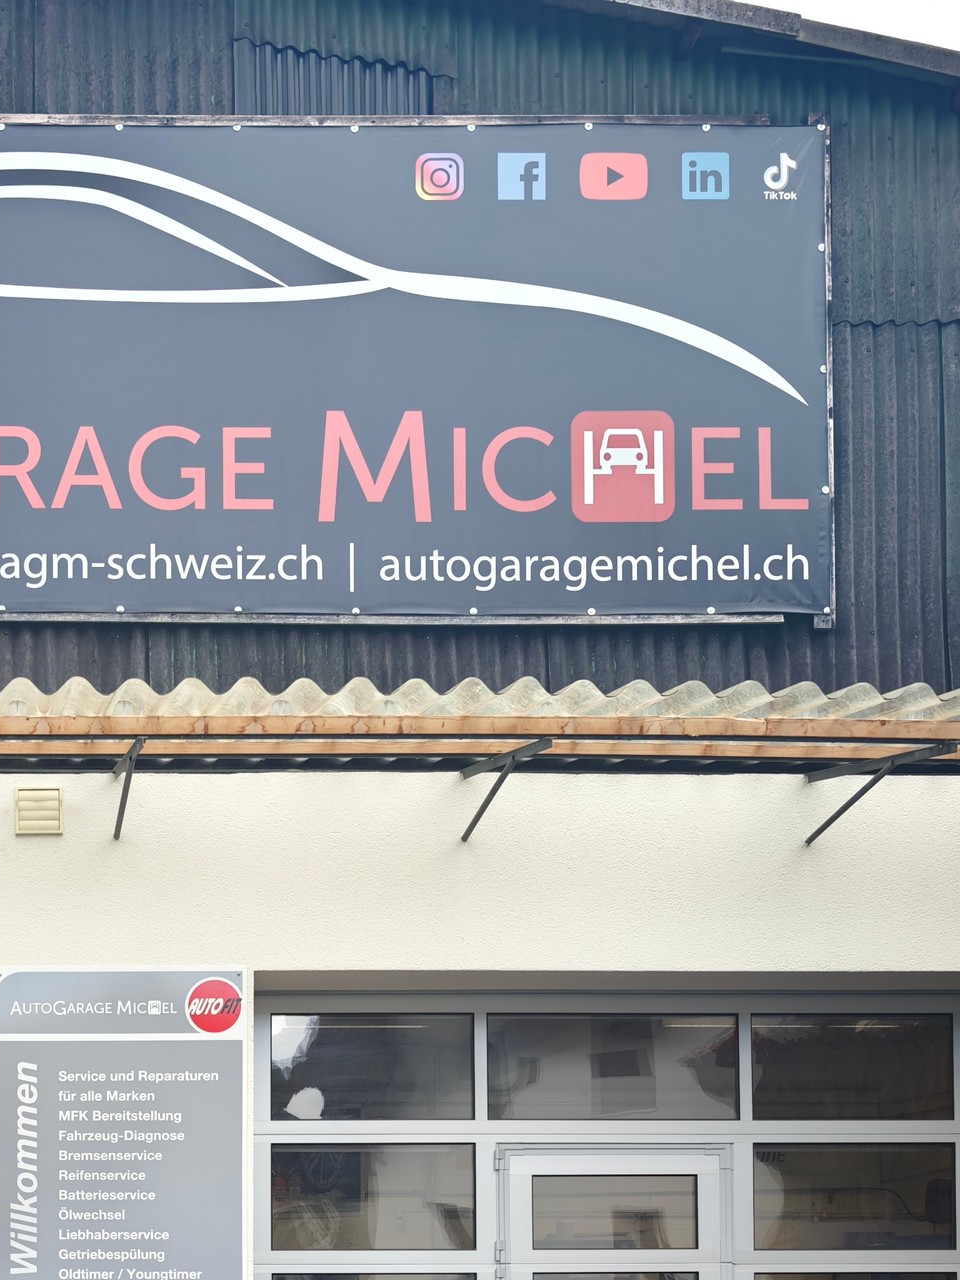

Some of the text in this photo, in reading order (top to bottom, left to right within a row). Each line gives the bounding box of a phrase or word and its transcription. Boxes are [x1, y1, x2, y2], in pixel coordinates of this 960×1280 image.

[688, 160, 723, 193] in
[763, 191, 798, 201] TikTok
[379, 543, 810, 592] autogaragemichel.ch
[58, 1070, 219, 1084] Service und Reparaturen
[58, 1090, 155, 1102] für alle Marken
[58, 1110, 182, 1124] MFK Bereitstellung
[58, 1129, 185, 1144] Fahrzeug-Diagnose
[58, 1149, 163, 1161] Bremsenservice
[9, 1061, 38, 1276] Willkommen
[58, 1169, 146, 1181] Reifenservice
[58, 1189, 156, 1201] Batterieservice
[58, 1206, 126, 1221] Ölwechsel
[58, 1228, 170, 1240] Liebhaberservice
[58, 1248, 166, 1263] Getriebespülung
[58, 1268, 115, 1280] Oldtimer
